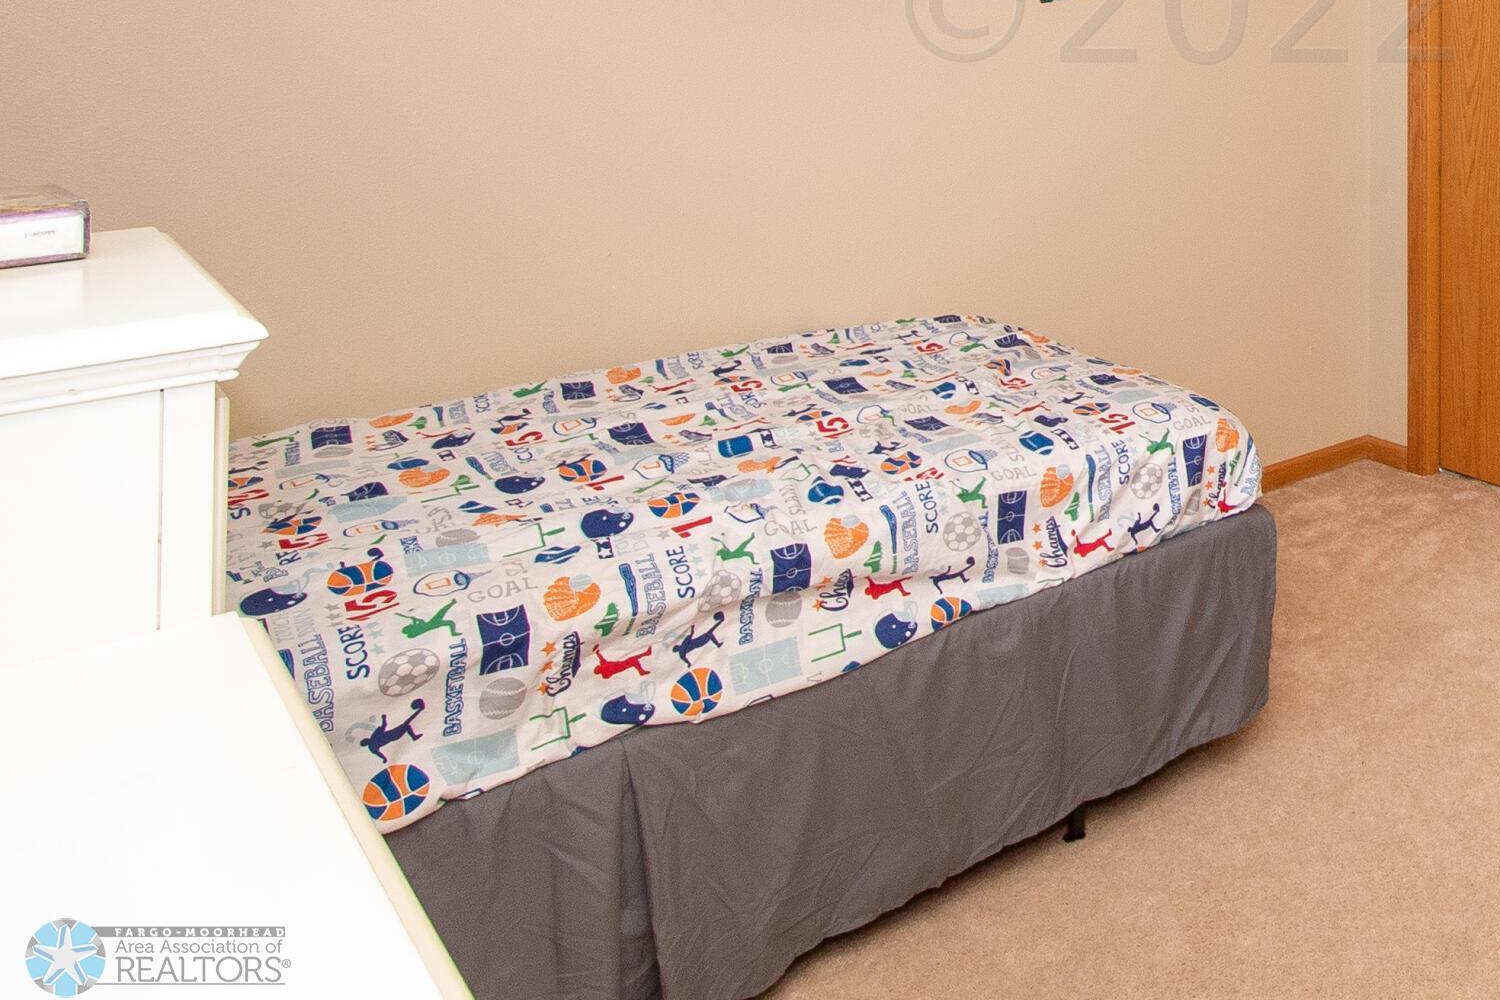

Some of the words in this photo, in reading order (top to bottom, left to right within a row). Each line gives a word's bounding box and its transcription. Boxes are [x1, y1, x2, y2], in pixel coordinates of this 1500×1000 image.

[1173, 415, 1211, 431] GOAL
[991, 466, 1038, 481] GOAL
[1111, 439, 1131, 485] SCORE
[893, 490, 919, 576] BASEBALL
[915, 481, 939, 534] SCORE
[1040, 516, 1068, 568] Champs
[467, 577, 539, 603] GOAL
[635, 553, 666, 638] BASEBALL
[666, 546, 696, 599] SCORE
[738, 568, 763, 645] BASKALL
[336, 624, 371, 680] SCORE
[298, 634, 334, 733] BASEBALL
[443, 638, 469, 737] BASKETBALL
